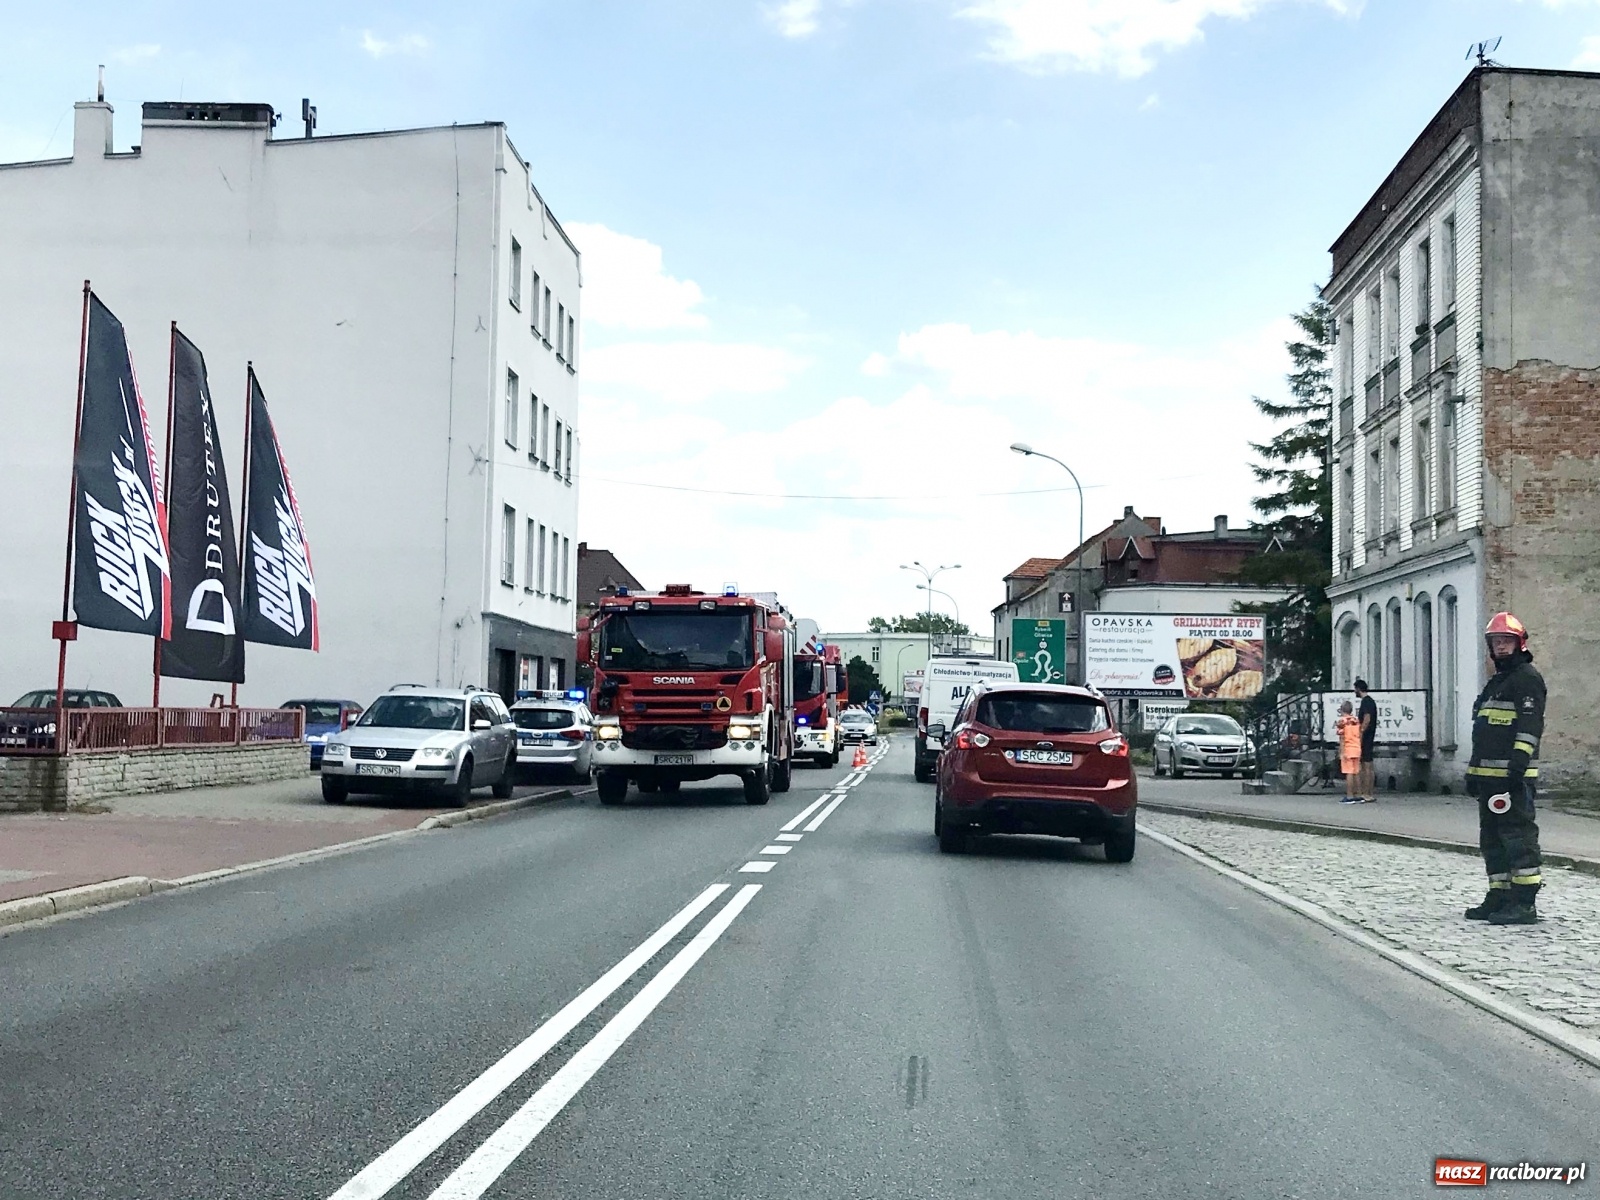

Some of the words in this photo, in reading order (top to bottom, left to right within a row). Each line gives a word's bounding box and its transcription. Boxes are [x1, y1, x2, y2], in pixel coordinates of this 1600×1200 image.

[200, 389, 225, 573] DRUTEX
[84, 490, 145, 620] RUCK
[251, 531, 296, 636] RUCK
[1092, 618, 1153, 626] OPAVSKA
[1173, 617, 1233, 628] GRILLUJEMY
[1236, 618, 1262, 628] RYBY
[1100, 626, 1145, 634] restauracja
[1189, 629, 1217, 638] PIĄTKI
[973, 670, 1012, 679] Klimatyzacja
[653, 676, 695, 684] SCANIA
[1022, 750, 1044, 761] SRC
[361, 765, 378, 774] SRC
